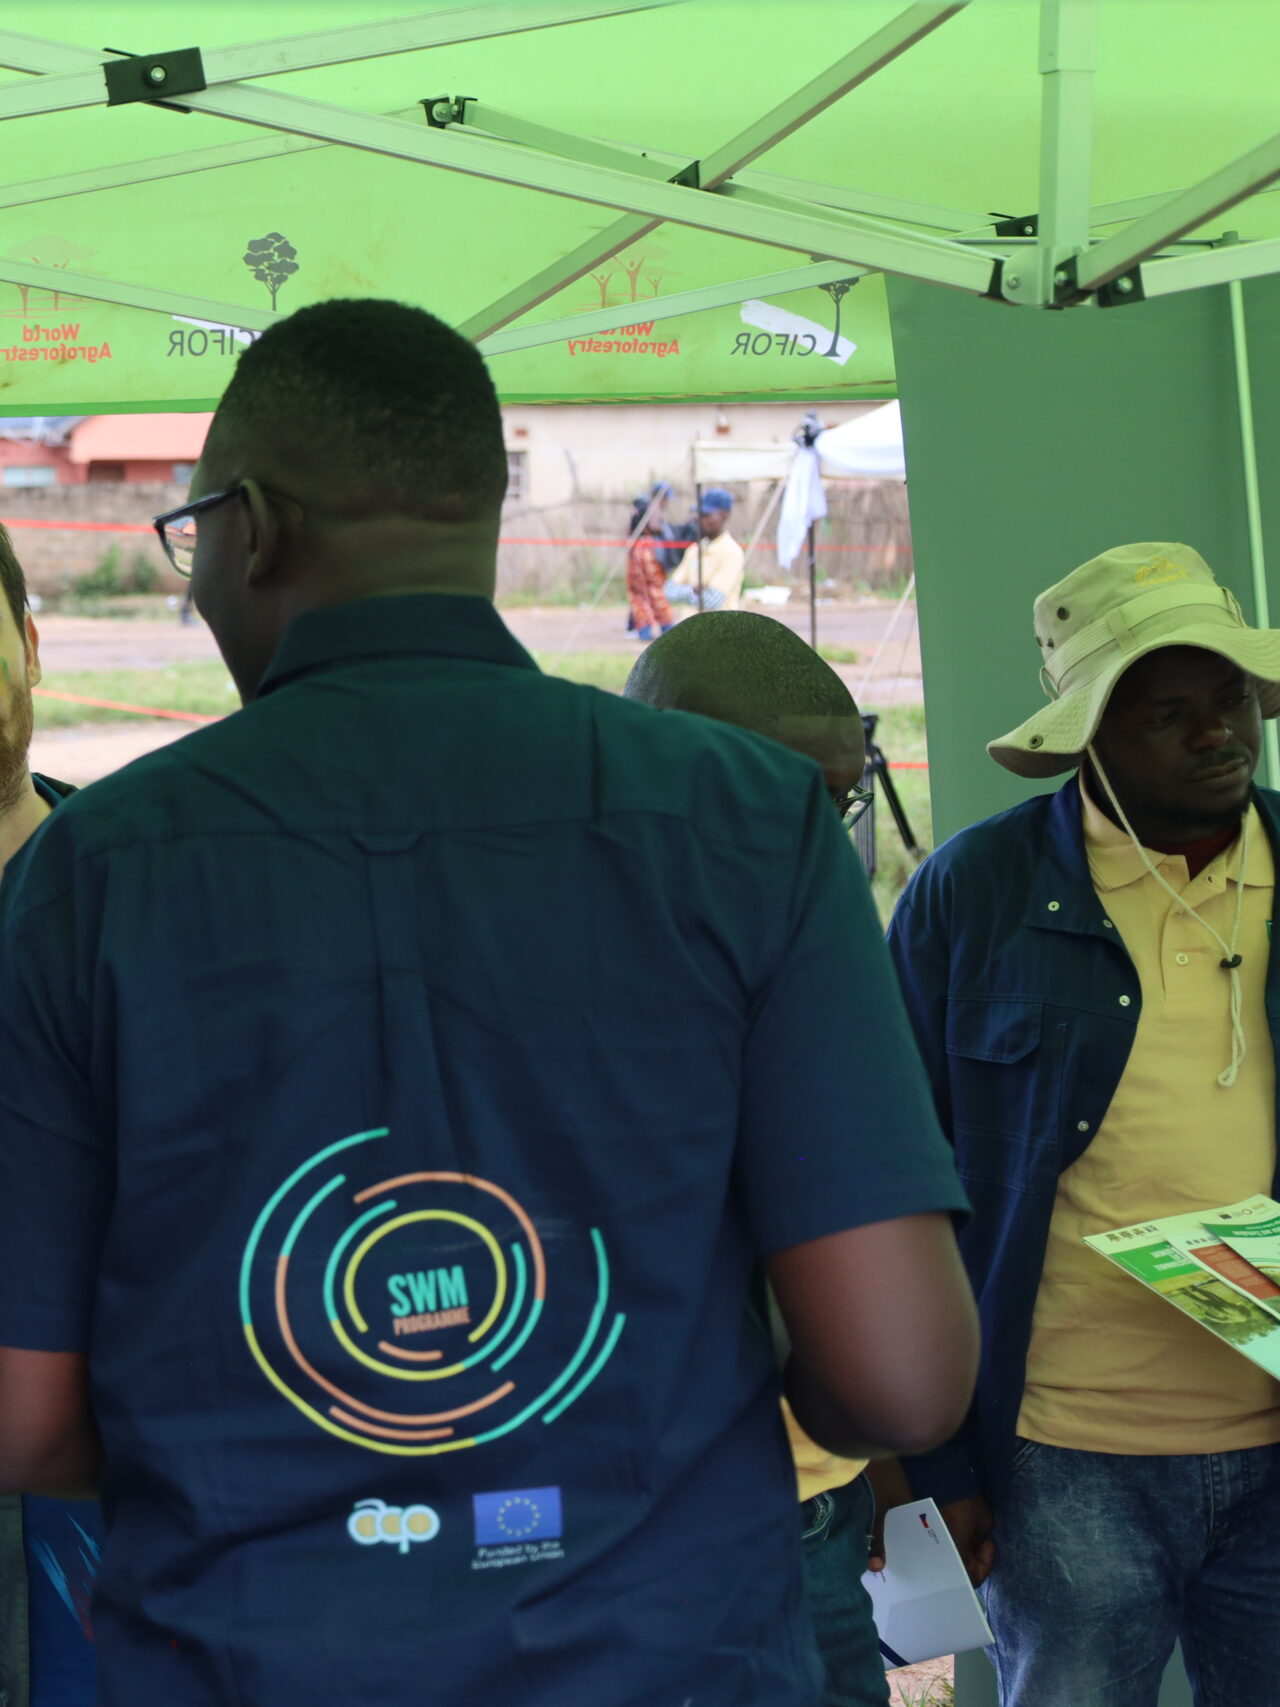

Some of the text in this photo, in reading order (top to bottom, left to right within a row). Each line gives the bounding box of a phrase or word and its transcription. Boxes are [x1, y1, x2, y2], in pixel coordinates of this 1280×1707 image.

[387, 1264, 468, 1317] SWM
[393, 1306, 471, 1336] PROGRAMME
[472, 1550, 564, 1570] European Union
[478, 1541, 561, 1559] Funded by the
